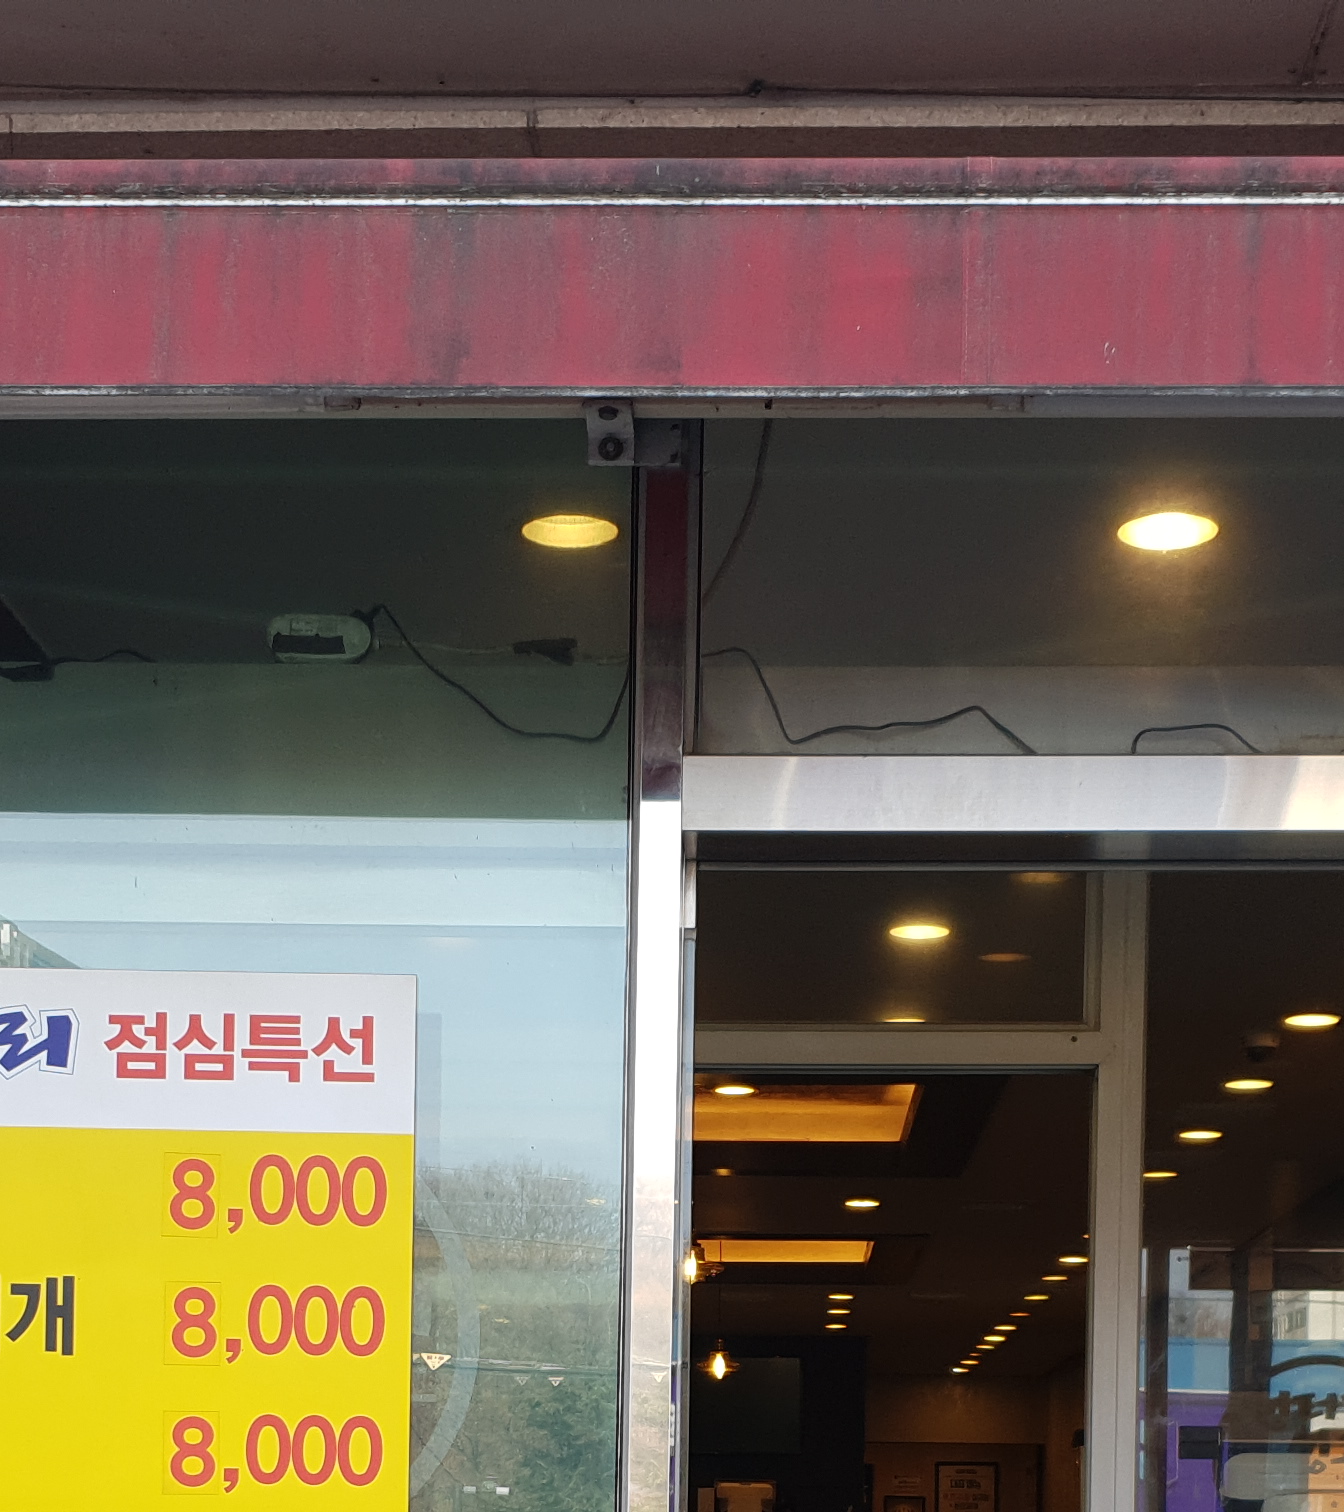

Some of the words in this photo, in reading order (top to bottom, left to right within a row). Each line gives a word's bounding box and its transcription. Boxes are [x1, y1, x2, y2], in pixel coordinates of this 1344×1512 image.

[104, 1012, 376, 1083] 점심특선
[169, 1155, 388, 1235] 8,000
[170, 1284, 386, 1364] 8,000
[170, 1414, 383, 1494] 8,000
